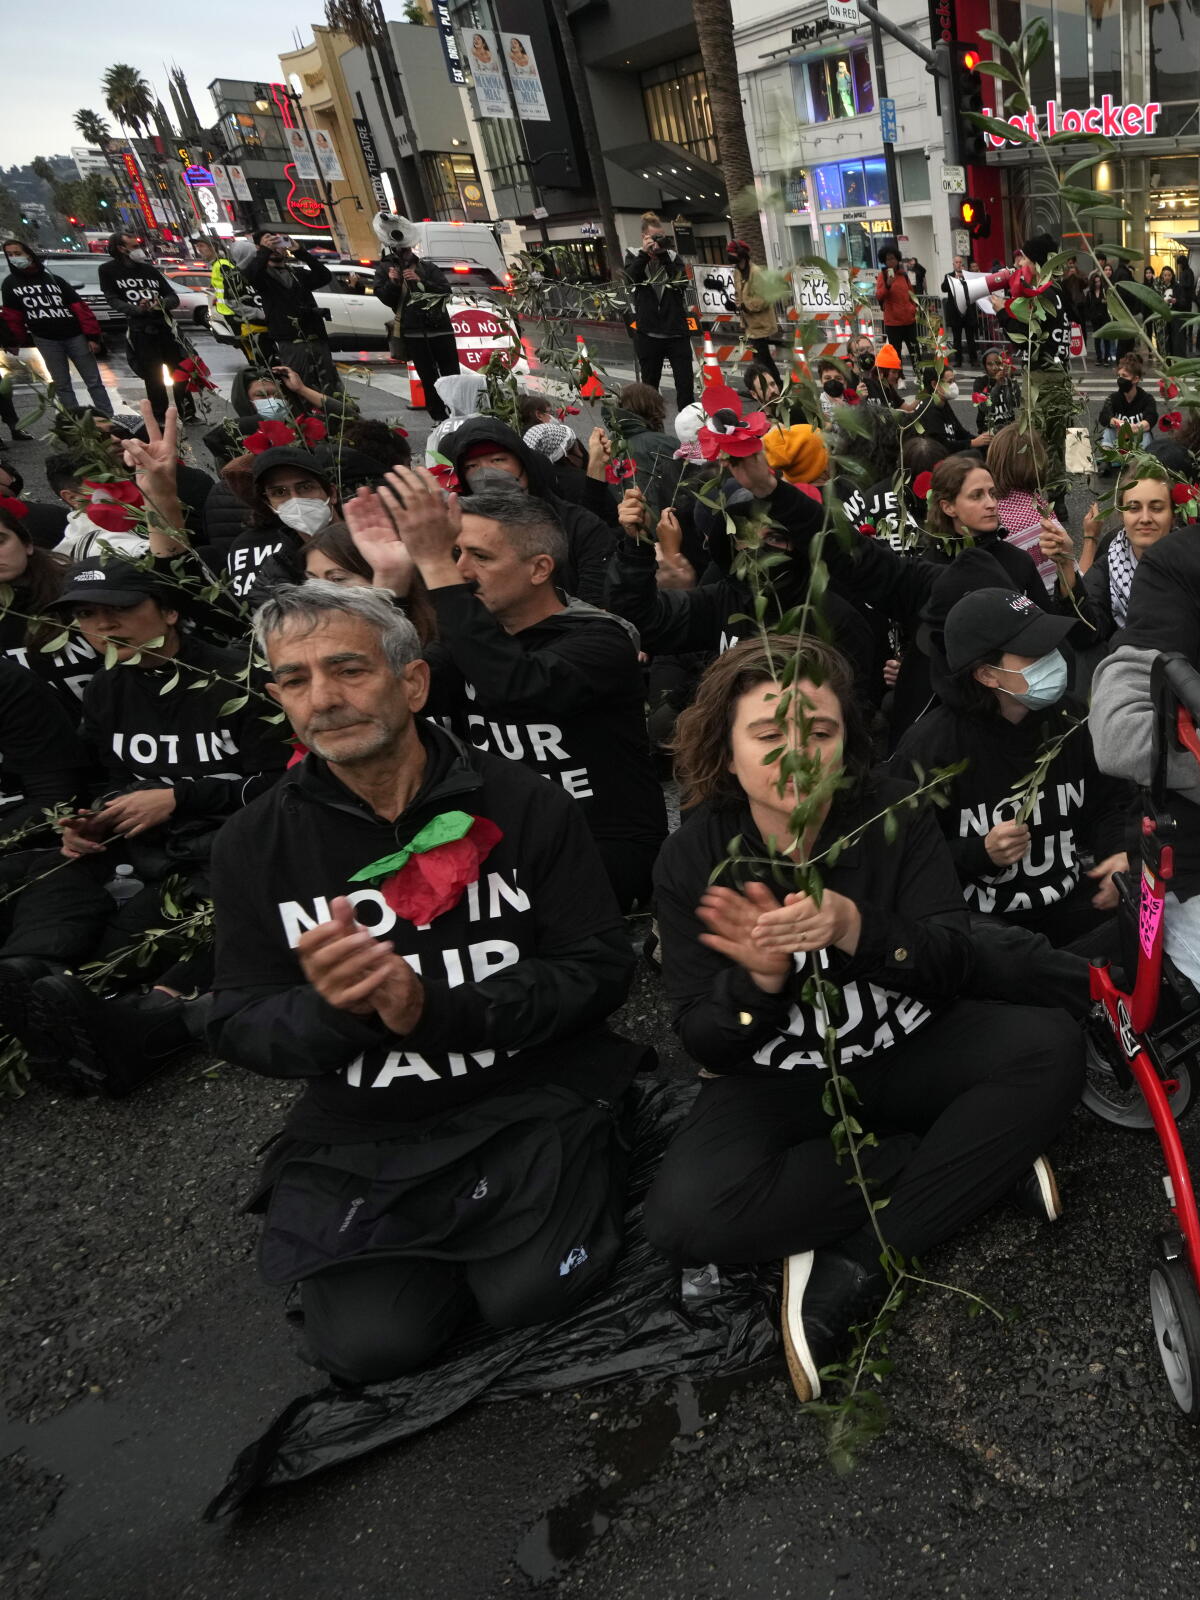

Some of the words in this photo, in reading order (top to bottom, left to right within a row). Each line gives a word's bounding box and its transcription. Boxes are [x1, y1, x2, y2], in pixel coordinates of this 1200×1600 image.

[438, 5, 451, 26] PLAY
[830, 8, 840, 16] ON
[842, 8, 857, 20] RED
[446, 35, 459, 60] DRINK
[452, 68, 465, 83] EAT
[982, 105, 1039, 147] oot
[1046, 94, 1161, 138] Locker
[360, 124, 379, 177] THEATRE
[943, 181, 952, 190] OK
[13, 285, 42, 297] NOT
[48, 283, 62, 294] IN
[116, 278, 144, 290] NOT
[22, 295, 64, 310] OUR
[799, 293, 847, 306] CLOSD
[27, 307, 74, 320] NAME
[453, 321, 471, 334] DO
[1056, 778, 1085, 817] IN
